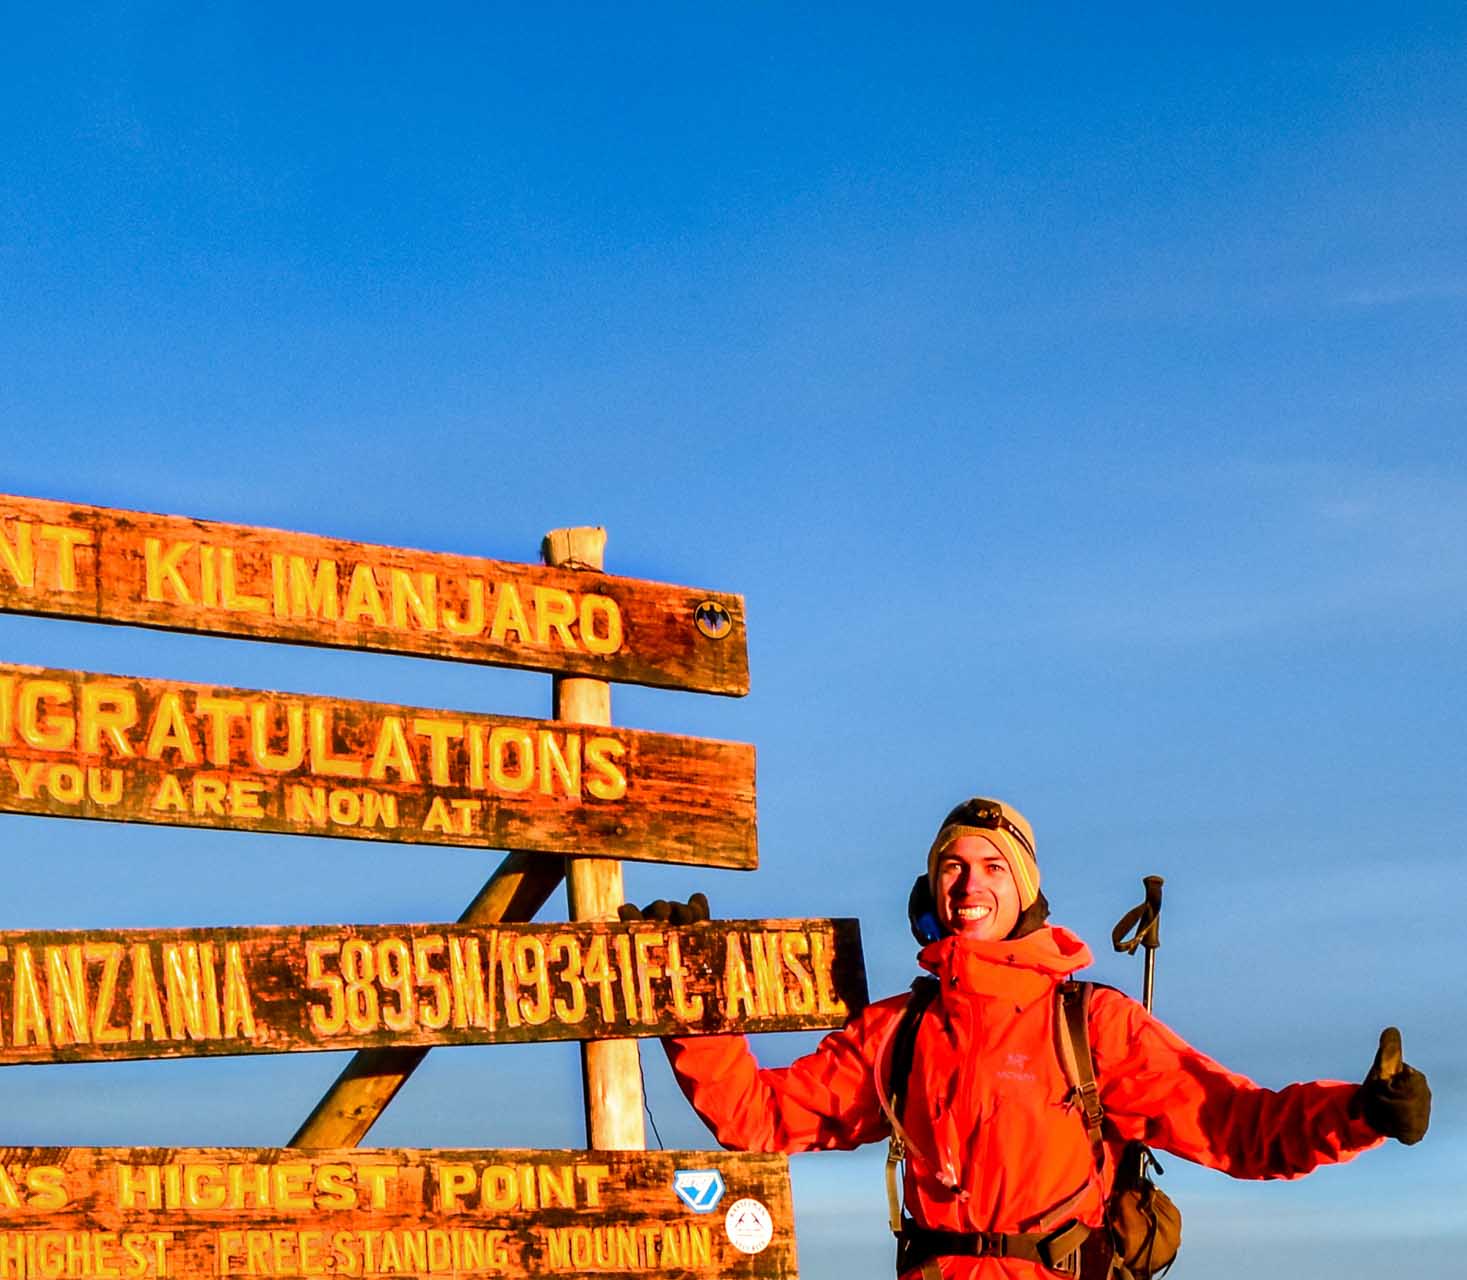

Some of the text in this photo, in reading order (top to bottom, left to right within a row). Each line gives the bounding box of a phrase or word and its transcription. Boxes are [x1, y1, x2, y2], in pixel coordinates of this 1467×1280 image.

[145, 537, 623, 656] KILIMANJARO
[9, 758, 482, 836] YOU ARE NOW AT
[725, 931, 847, 1019] AMSL
[119, 1164, 399, 1209] HIGHEST
[438, 1164, 609, 1210] POINT
[0, 1231, 174, 1279] HIGHEST
[547, 1224, 712, 1270] MOUNTAIN
